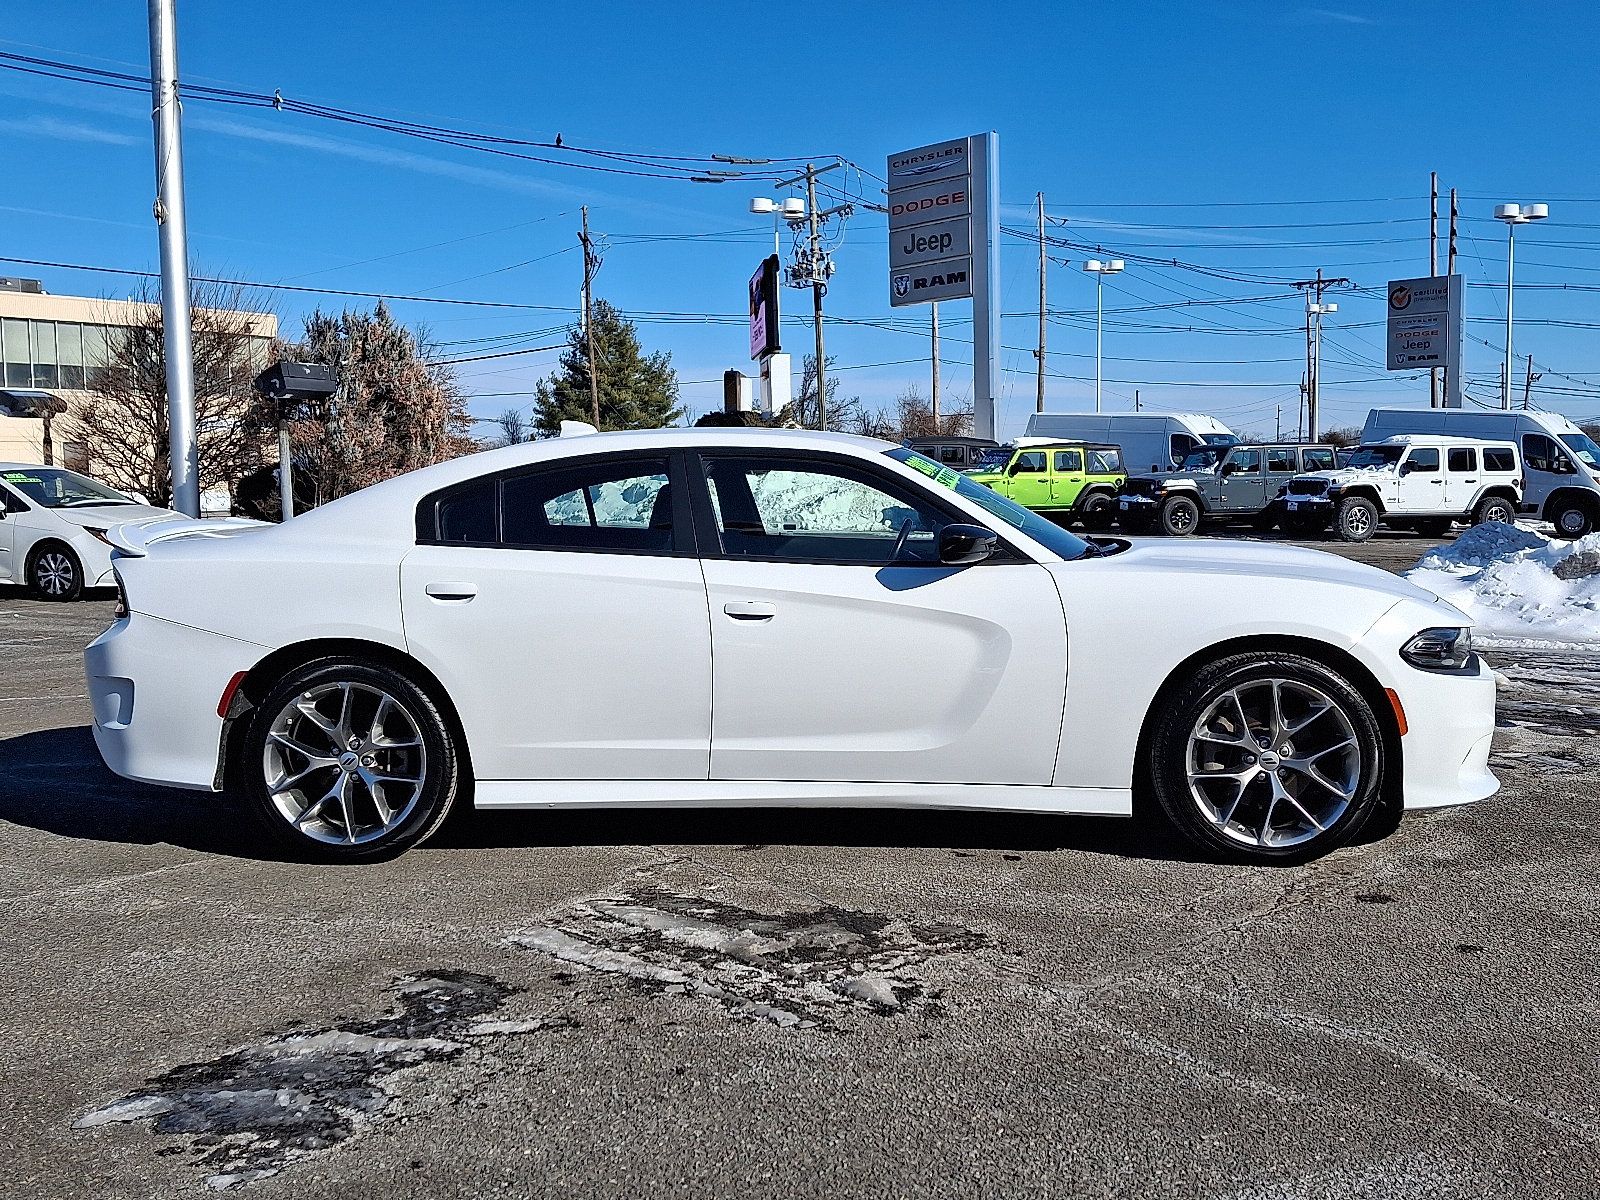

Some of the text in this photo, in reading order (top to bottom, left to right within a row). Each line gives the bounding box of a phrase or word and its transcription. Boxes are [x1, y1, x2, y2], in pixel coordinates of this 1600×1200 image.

[892, 147, 963, 168] CHRYSLER
[891, 191, 965, 216] DODGE
[903, 232, 953, 255] Jeep
[913, 271, 967, 290] RAM
[1395, 330, 1439, 338] DODGE
[1402, 340, 1431, 350] Jeep
